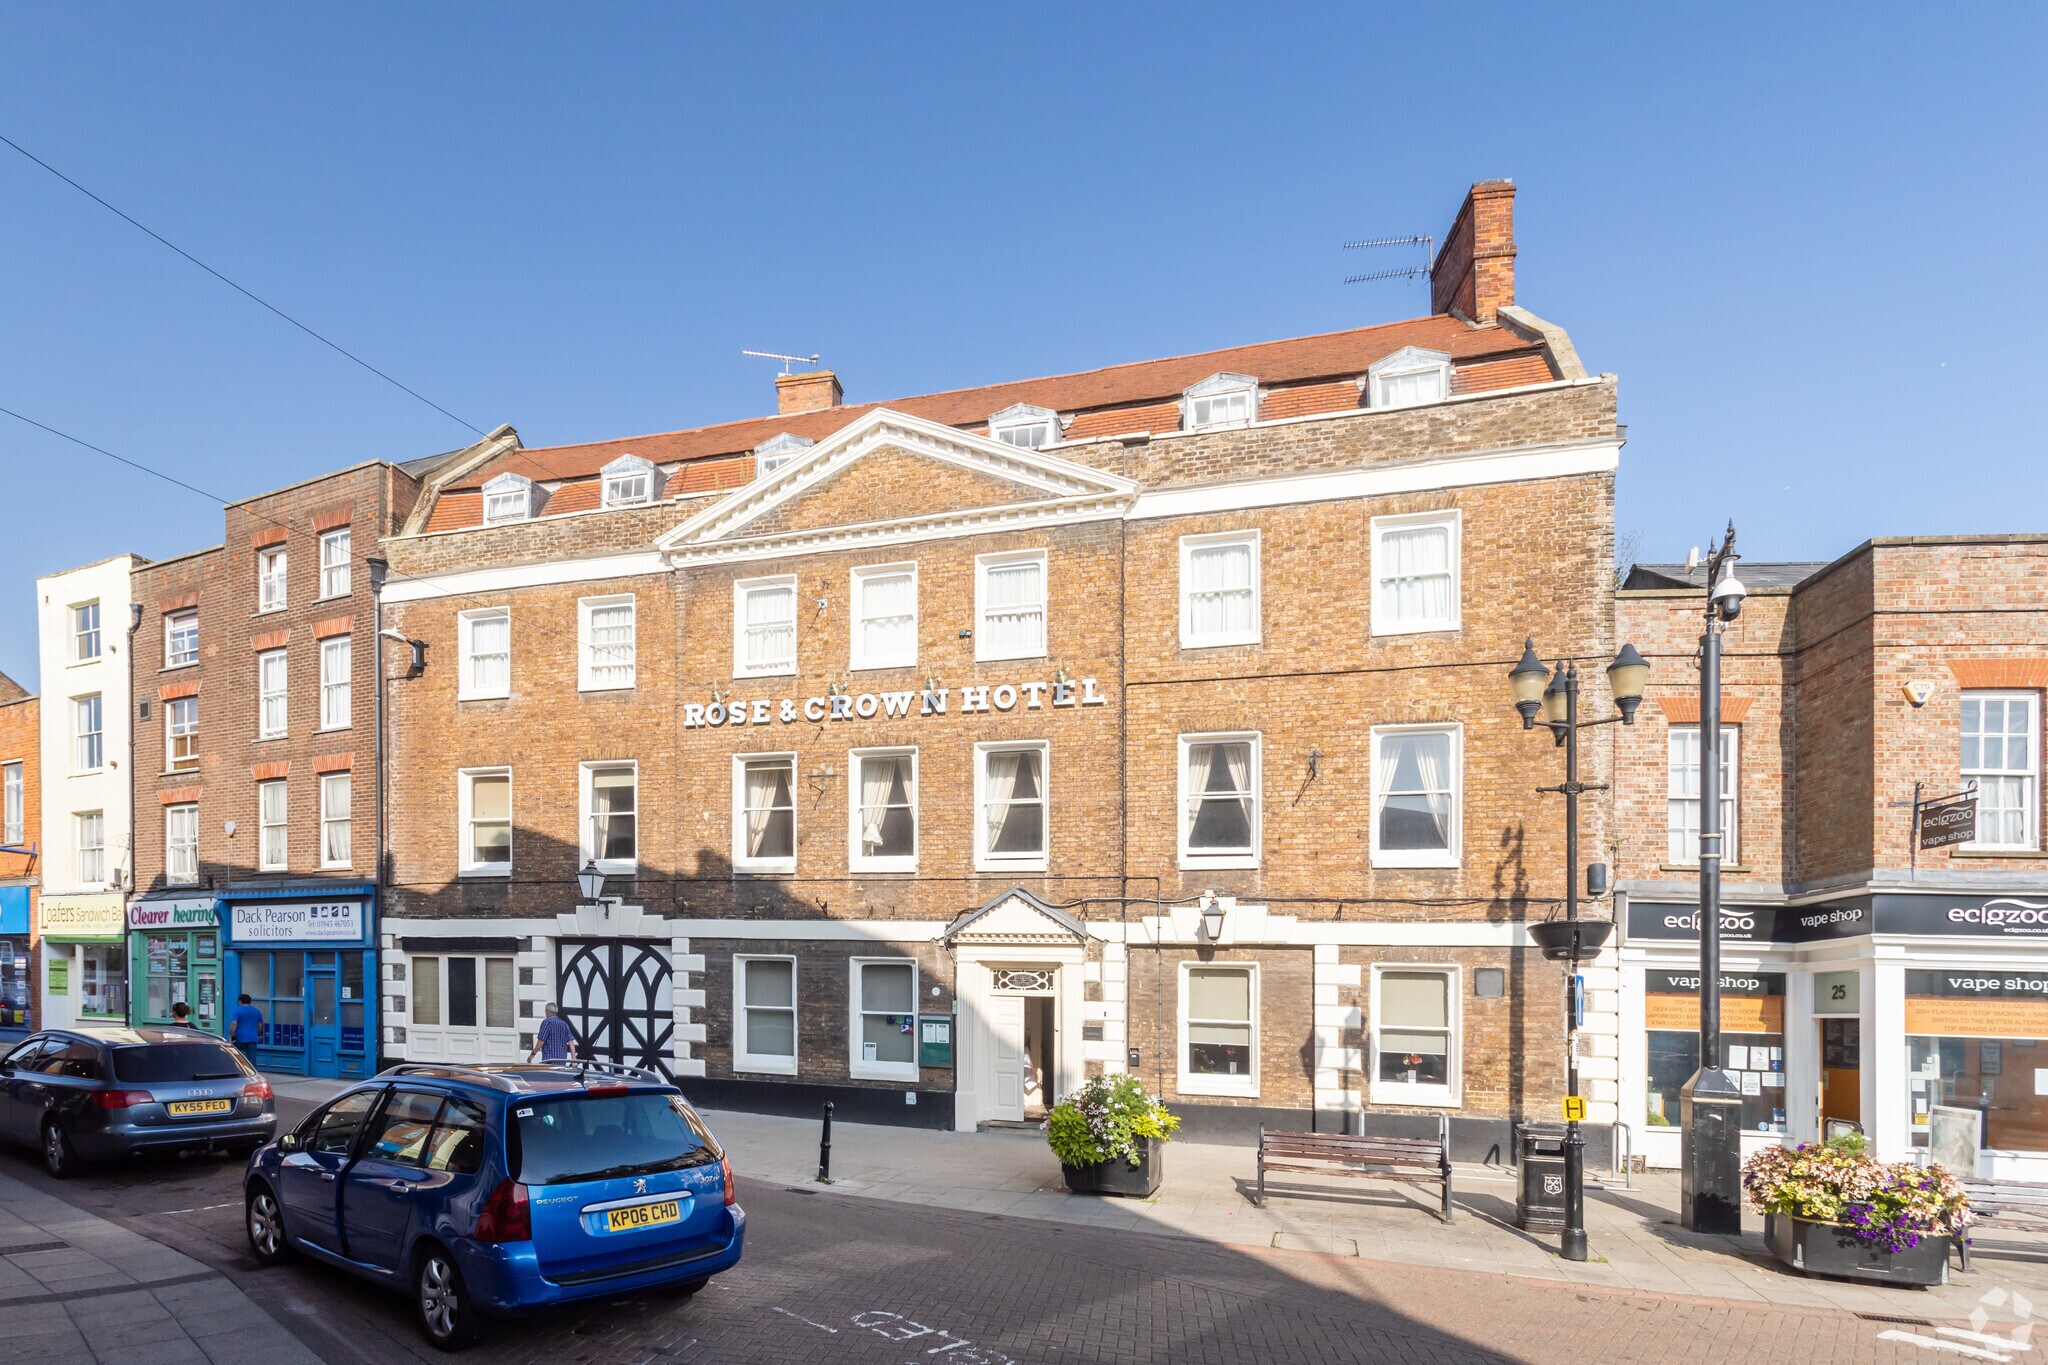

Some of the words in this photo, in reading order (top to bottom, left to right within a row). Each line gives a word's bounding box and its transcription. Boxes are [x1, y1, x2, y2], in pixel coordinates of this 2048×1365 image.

[683, 699, 771, 728] ROSE
[780, 698, 798, 723] &
[804, 688, 949, 722] CROWN
[961, 678, 1108, 713] HOTEL
[1922, 834, 1946, 846] vape
[1947, 829, 1974, 842] shop
[41, 902, 75, 929] Loafers
[76, 906, 110, 922] Sandwich
[130, 906, 170, 925] Clearer
[173, 904, 216, 925] hearing
[237, 907, 262, 924] Dack
[265, 908, 306, 923] Pearson
[1663, 914, 1755, 931] ecizoo
[1800, 914, 1828, 928] vape
[1830, 908, 1863, 923] shop
[248, 924, 293, 937] solicitors
[1667, 976, 1700, 989] vap
[1719, 976, 1760, 991] shop
[1831, 984, 1846, 1000] 25
[1948, 978, 2001, 992] vape
[174, 1102, 203, 1112] KY55
[205, 1101, 226, 1110] FEO
[1566, 1098, 1583, 1118] H
[536, 1196, 579, 1205] PEUGEOT
[611, 1208, 649, 1228] KP06
[651, 1202, 678, 1220] CHD
